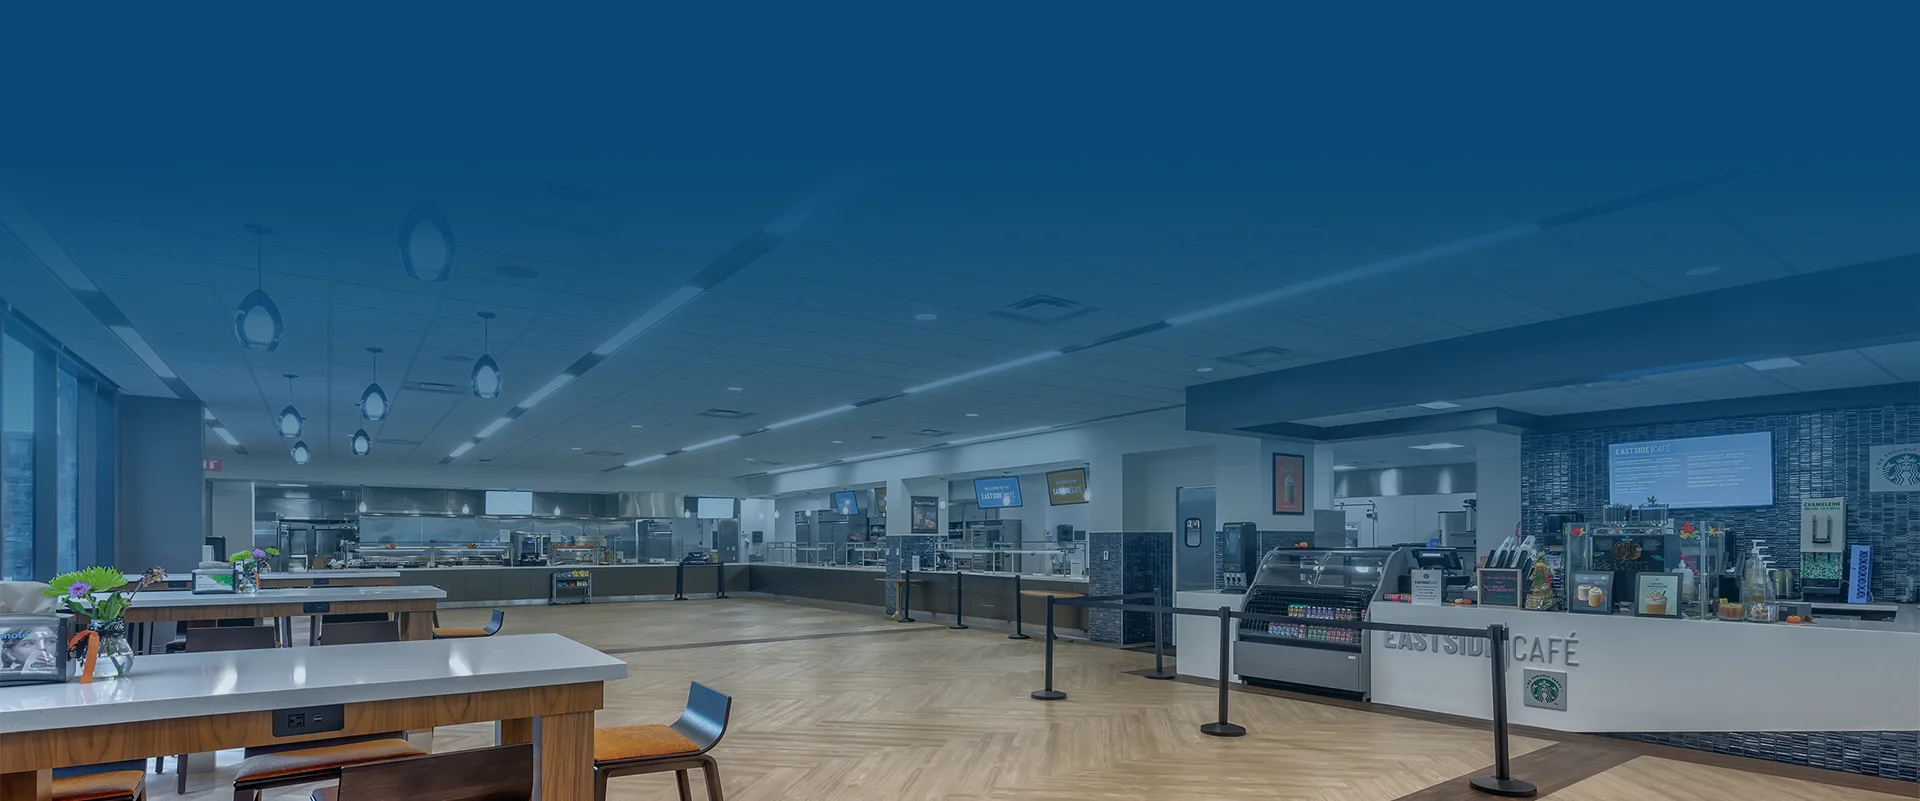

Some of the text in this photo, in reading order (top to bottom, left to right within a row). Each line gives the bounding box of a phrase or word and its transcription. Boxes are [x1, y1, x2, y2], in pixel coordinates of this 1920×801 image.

[1616, 444, 1671, 455] EASTSIDE CAFÉ
[1884, 447, 1917, 458] PROUDLY
[981, 492, 1003, 500] EASTSIDE
[1512, 632, 1580, 667] CAFÉ
